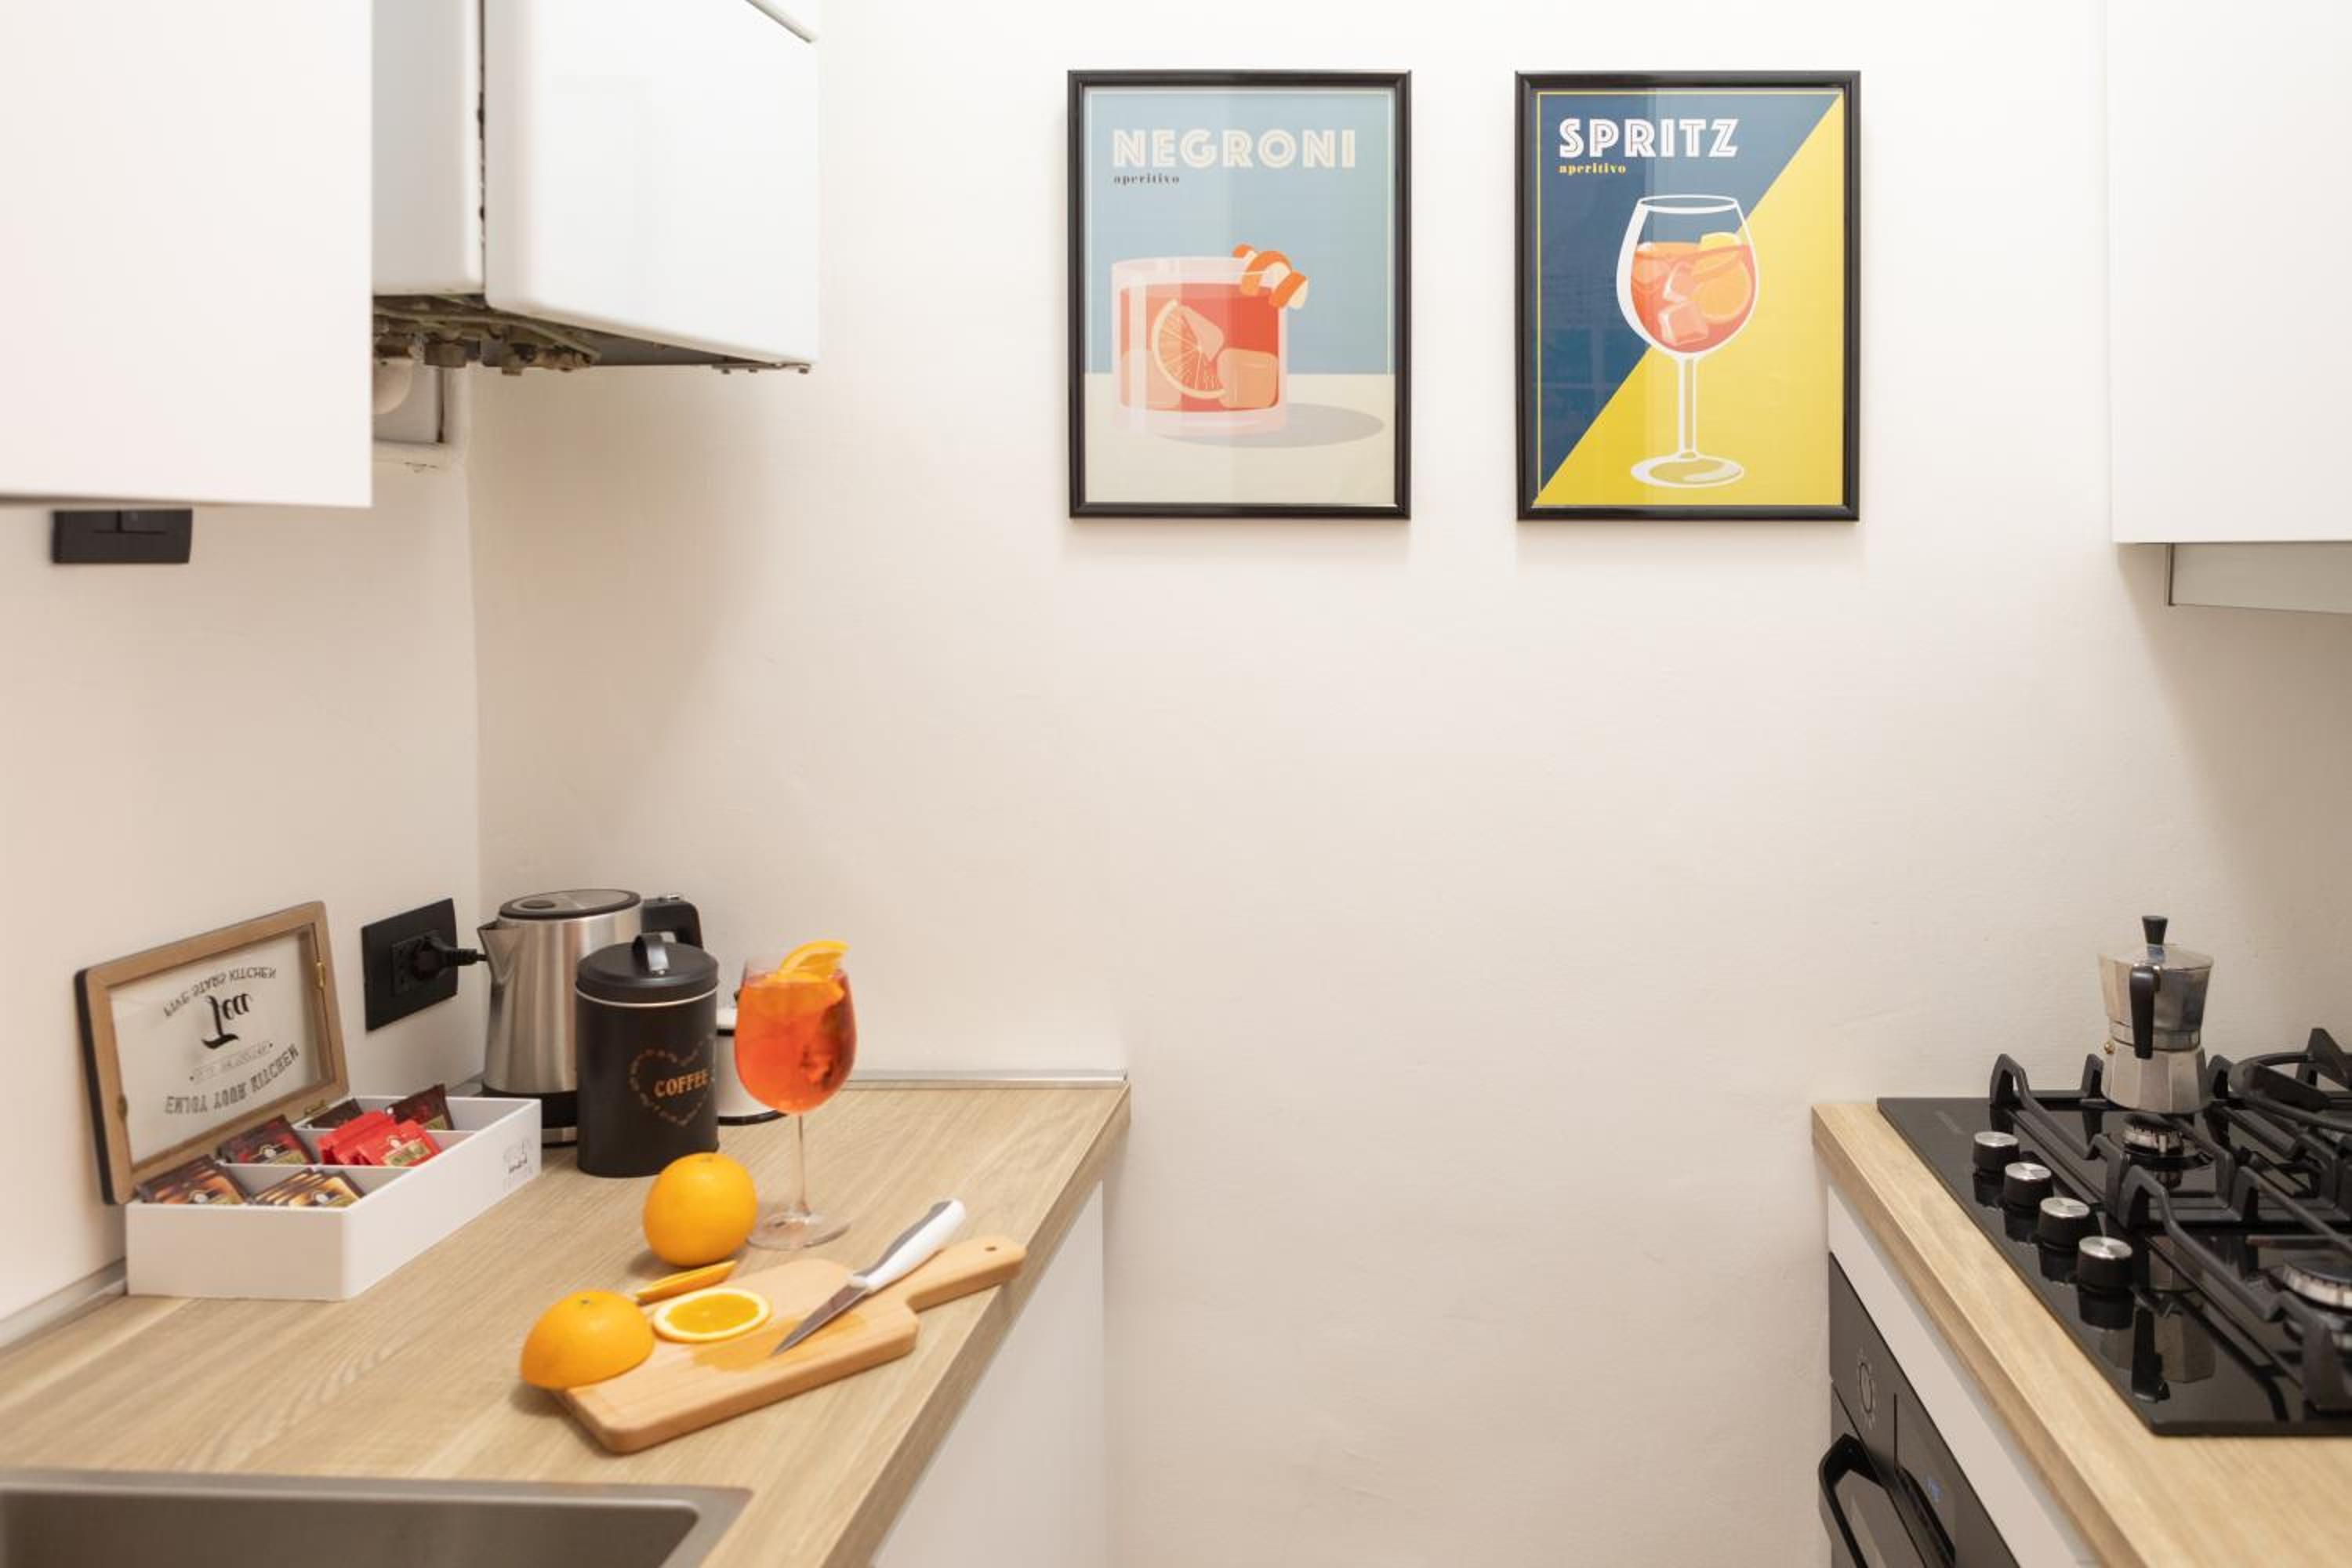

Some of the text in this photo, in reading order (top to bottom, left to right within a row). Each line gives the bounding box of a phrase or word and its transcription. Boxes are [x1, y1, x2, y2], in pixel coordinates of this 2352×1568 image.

[1112, 128, 1356, 169] NEGRONI
[1559, 118, 1739, 158] SPRITZ
[1113, 172, 1181, 187] aperitivo
[1559, 162, 1627, 176] aperitivo
[654, 1067, 710, 1098] COFFEE
